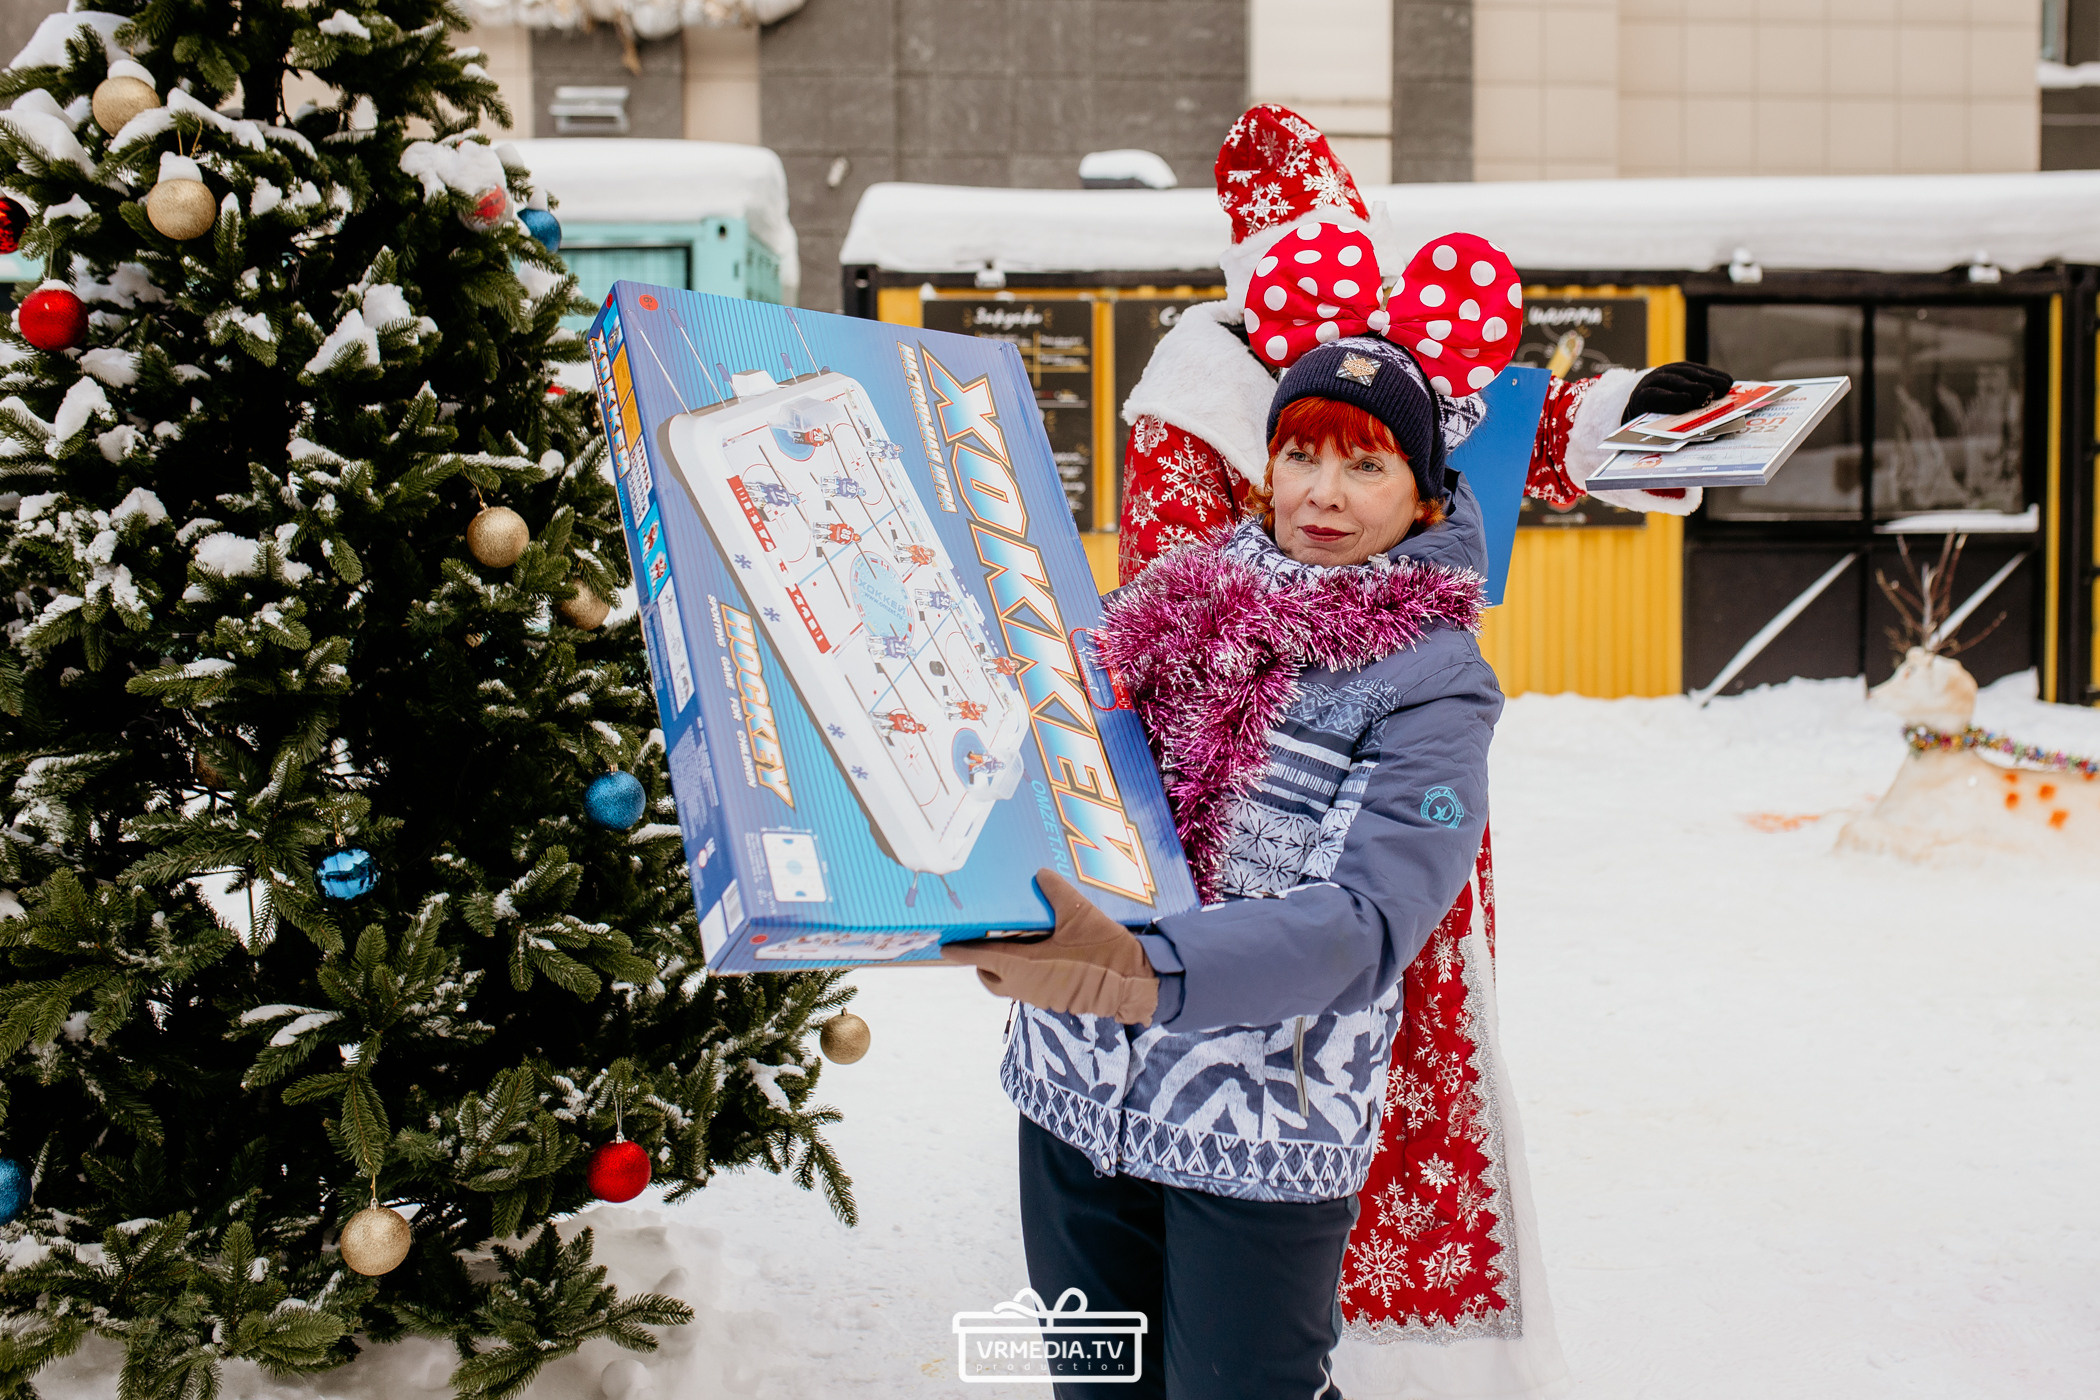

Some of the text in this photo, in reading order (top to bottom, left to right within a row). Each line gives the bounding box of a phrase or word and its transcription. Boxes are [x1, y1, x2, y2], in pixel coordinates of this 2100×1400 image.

[643, 297, 653, 309] 6+
[591, 329, 632, 479] ХОККЕЙ
[897, 341, 958, 514] НАСТОЛЬНАЯ ИГРА
[840, 529, 851, 540] 88
[859, 578, 907, 615] ХОККЕЙ
[707, 594, 758, 788] SPORTING GAME FOR CHILDREN
[919, 340, 1158, 905] ХОККЕЙ
[720, 602, 797, 812] HOCKEY
[1031, 780, 1073, 878] OMZET.RU
